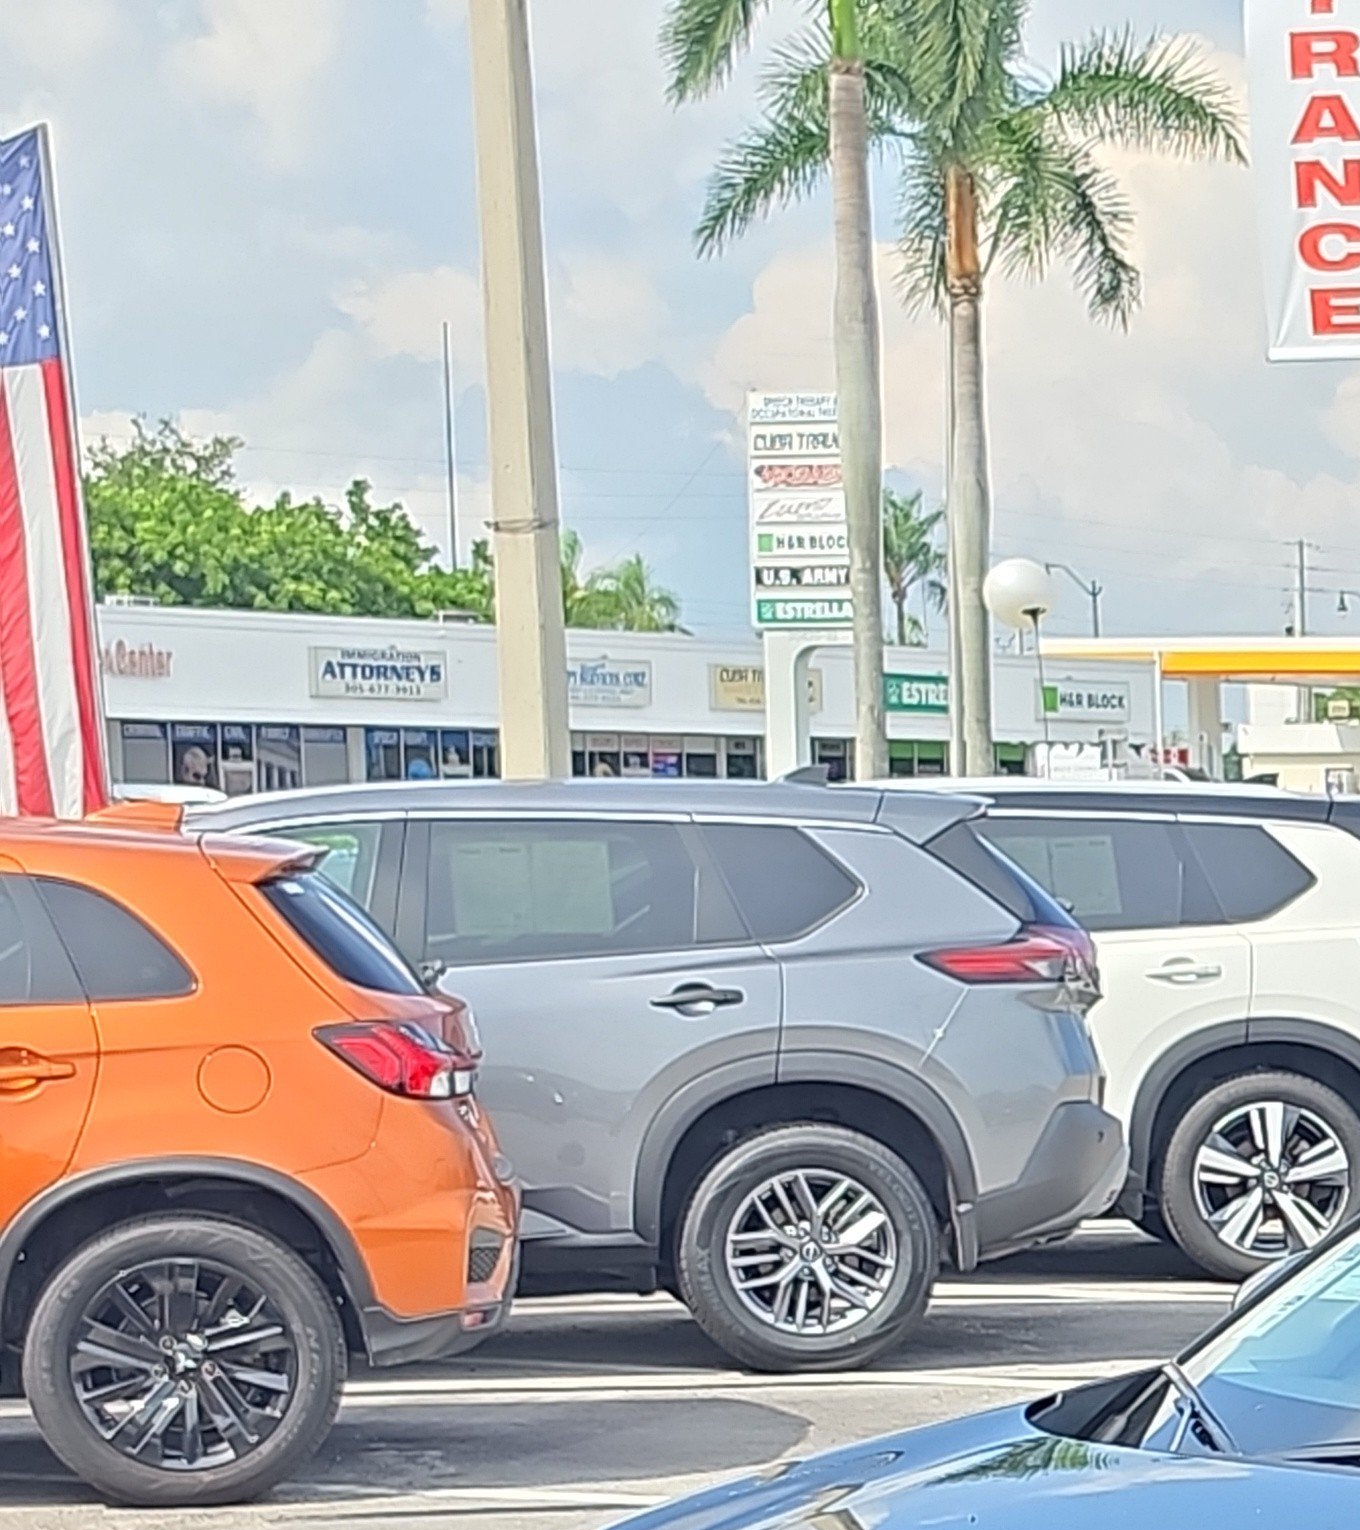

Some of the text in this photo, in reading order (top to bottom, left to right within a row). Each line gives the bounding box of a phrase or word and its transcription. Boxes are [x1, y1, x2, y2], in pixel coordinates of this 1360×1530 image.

[762, 567, 848, 586] U.S. ARMY
[321, 660, 442, 683] ATTORNEYS
[1087, 693, 1125, 709] BLOCK
